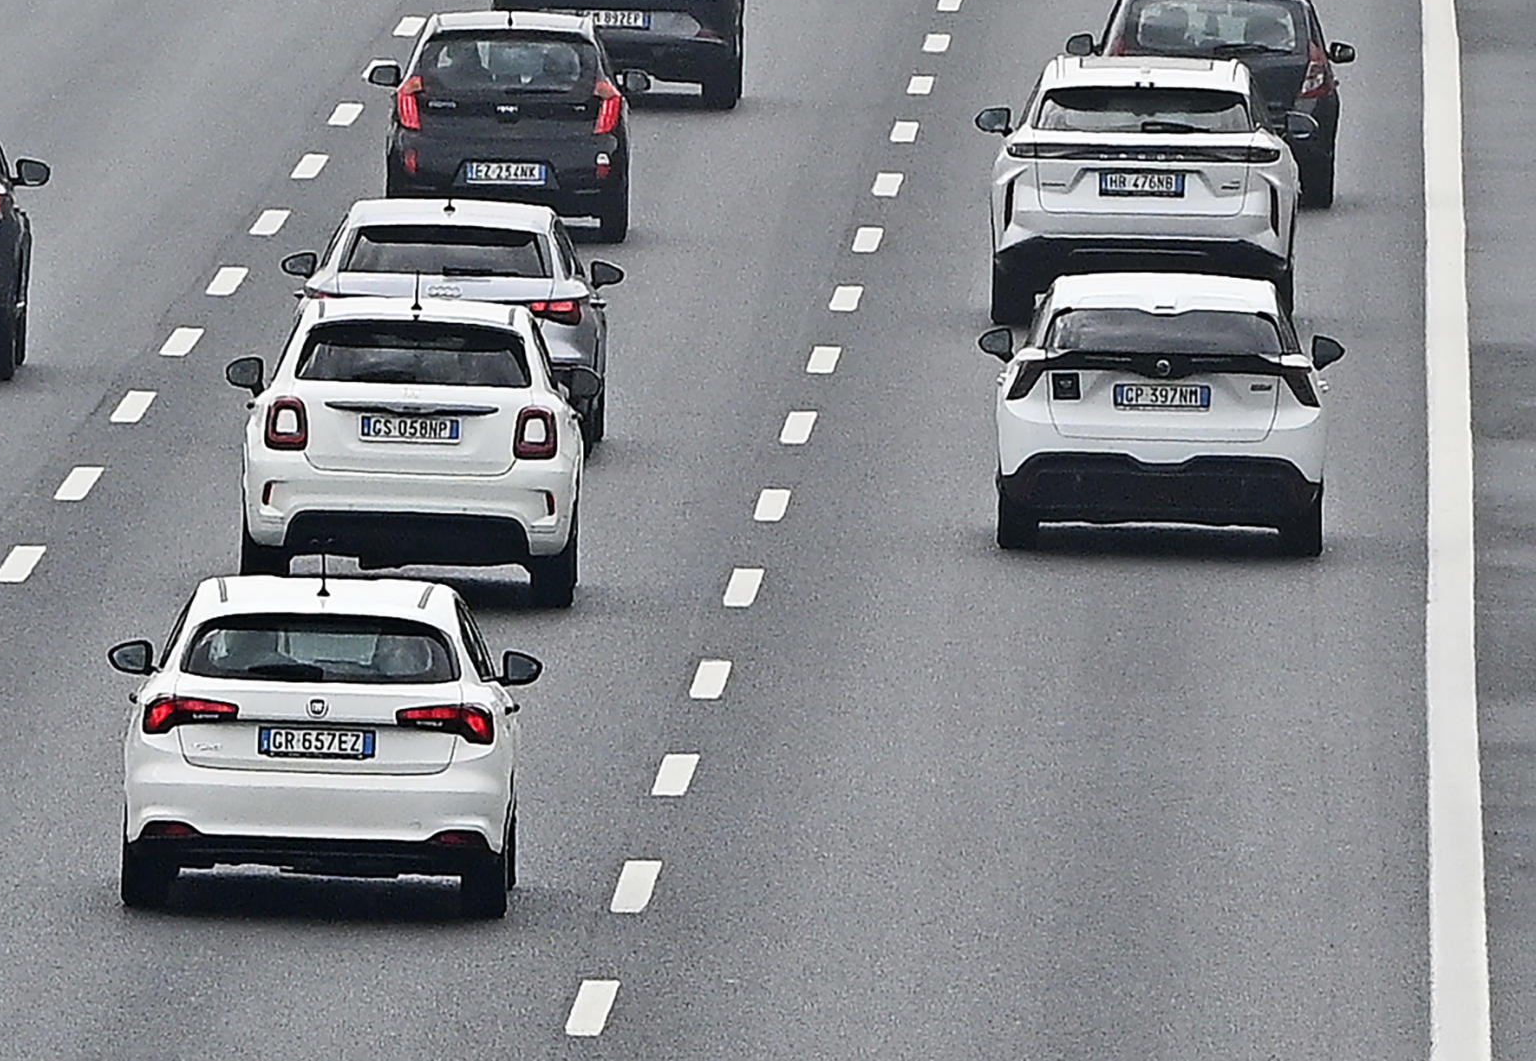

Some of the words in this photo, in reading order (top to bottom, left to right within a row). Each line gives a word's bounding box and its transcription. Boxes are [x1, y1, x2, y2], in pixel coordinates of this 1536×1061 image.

[1150, 387, 1199, 405] 397NM
[372, 419, 393, 437] GS
[397, 419, 448, 439] 058NP
[271, 730, 296, 752] GR
[301, 731, 362, 753] 657EZ
